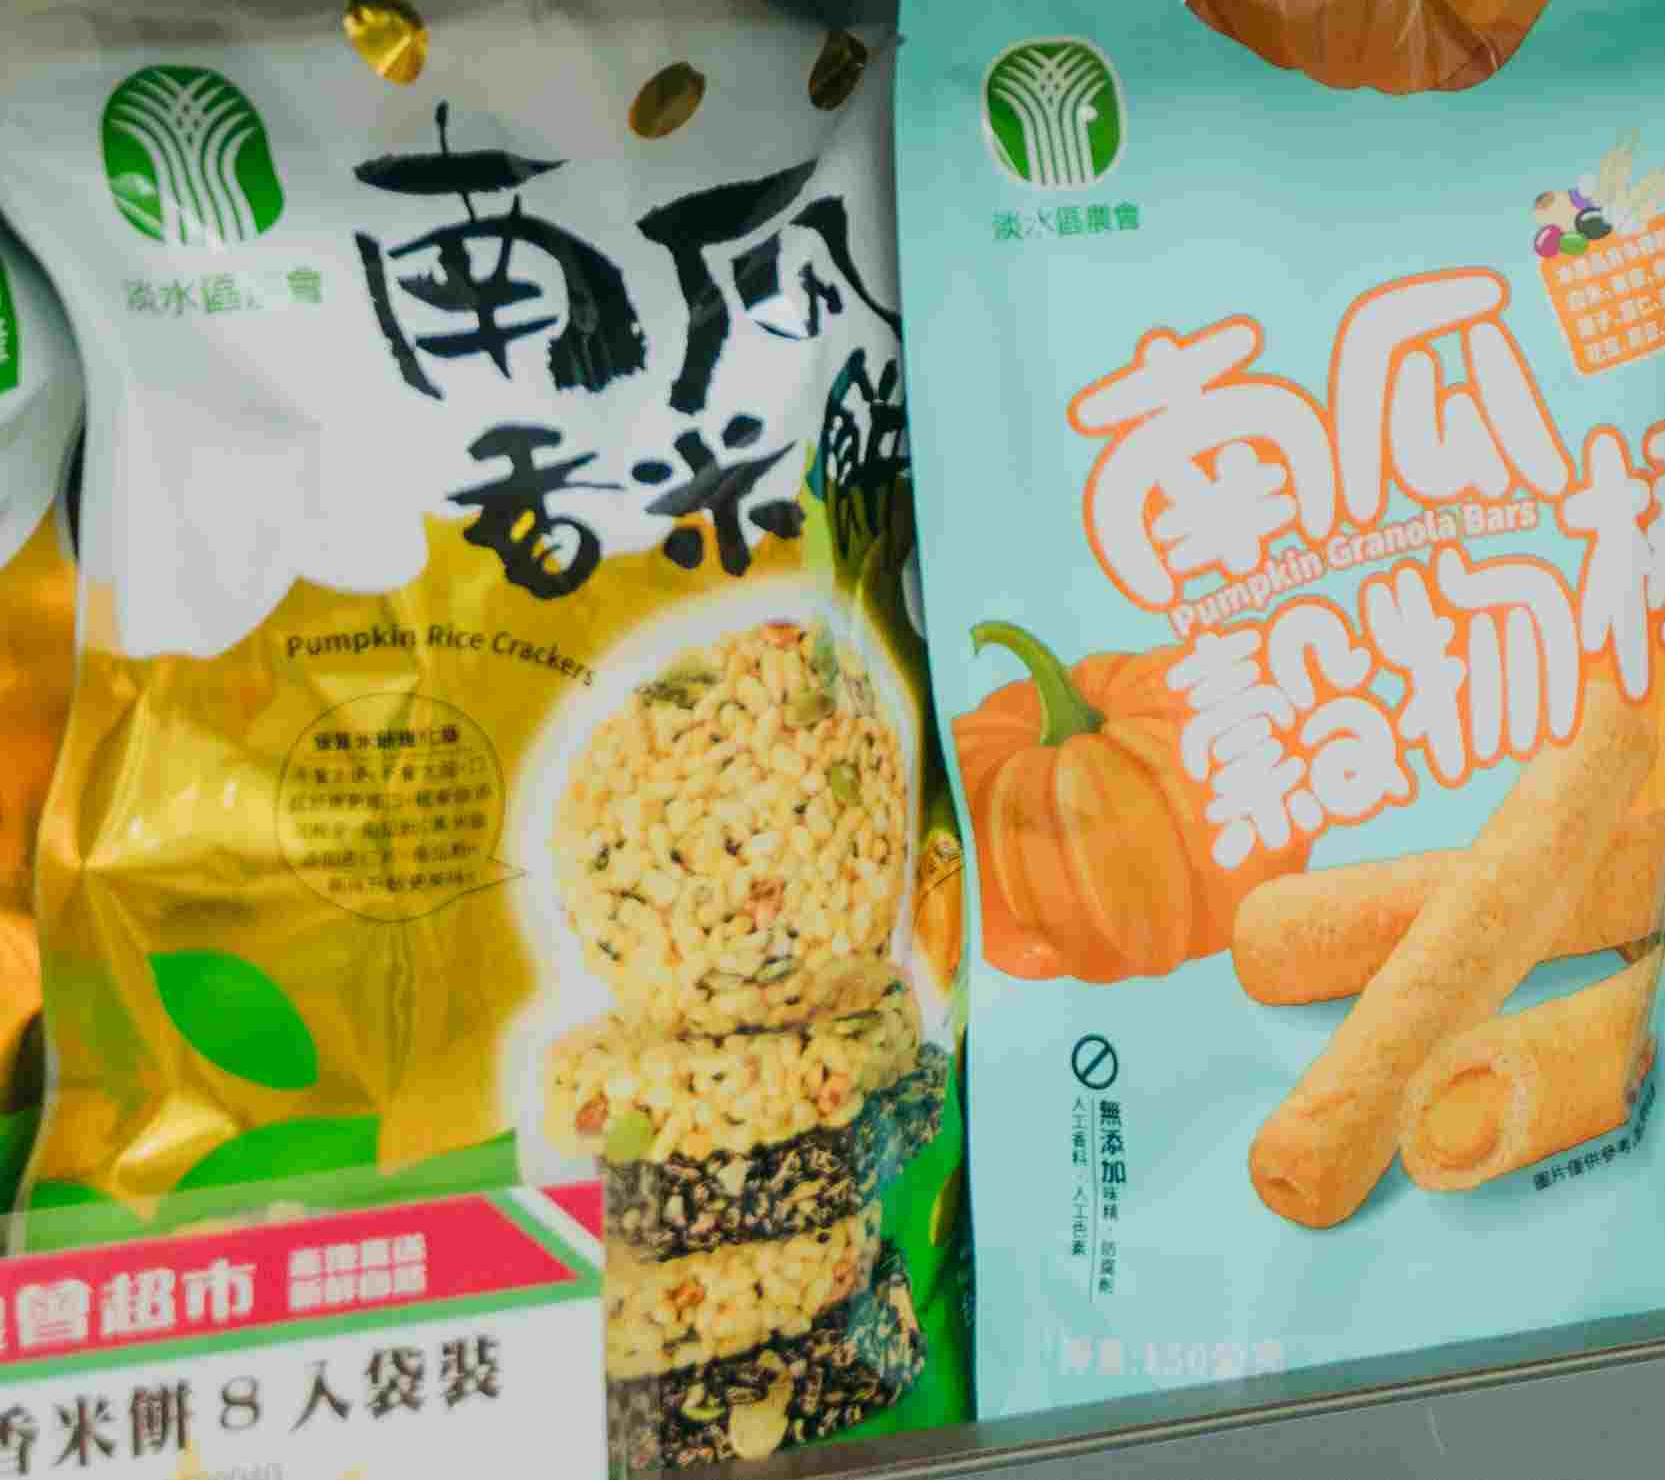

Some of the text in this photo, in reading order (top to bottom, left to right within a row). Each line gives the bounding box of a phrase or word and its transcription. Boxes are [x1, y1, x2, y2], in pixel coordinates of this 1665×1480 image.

[353, 99, 902, 417] 南瓜
[991, 201, 1142, 242] 淡水區農會
[125, 266, 323, 317] 淡水區會
[1066, 265, 1580, 613] 南瓜
[1170, 496, 1540, 634] Pumpkin Granola Bars
[286, 623, 597, 687] Pumpkin Rice Crackers
[0, 1255, 258, 1355] 會超市
